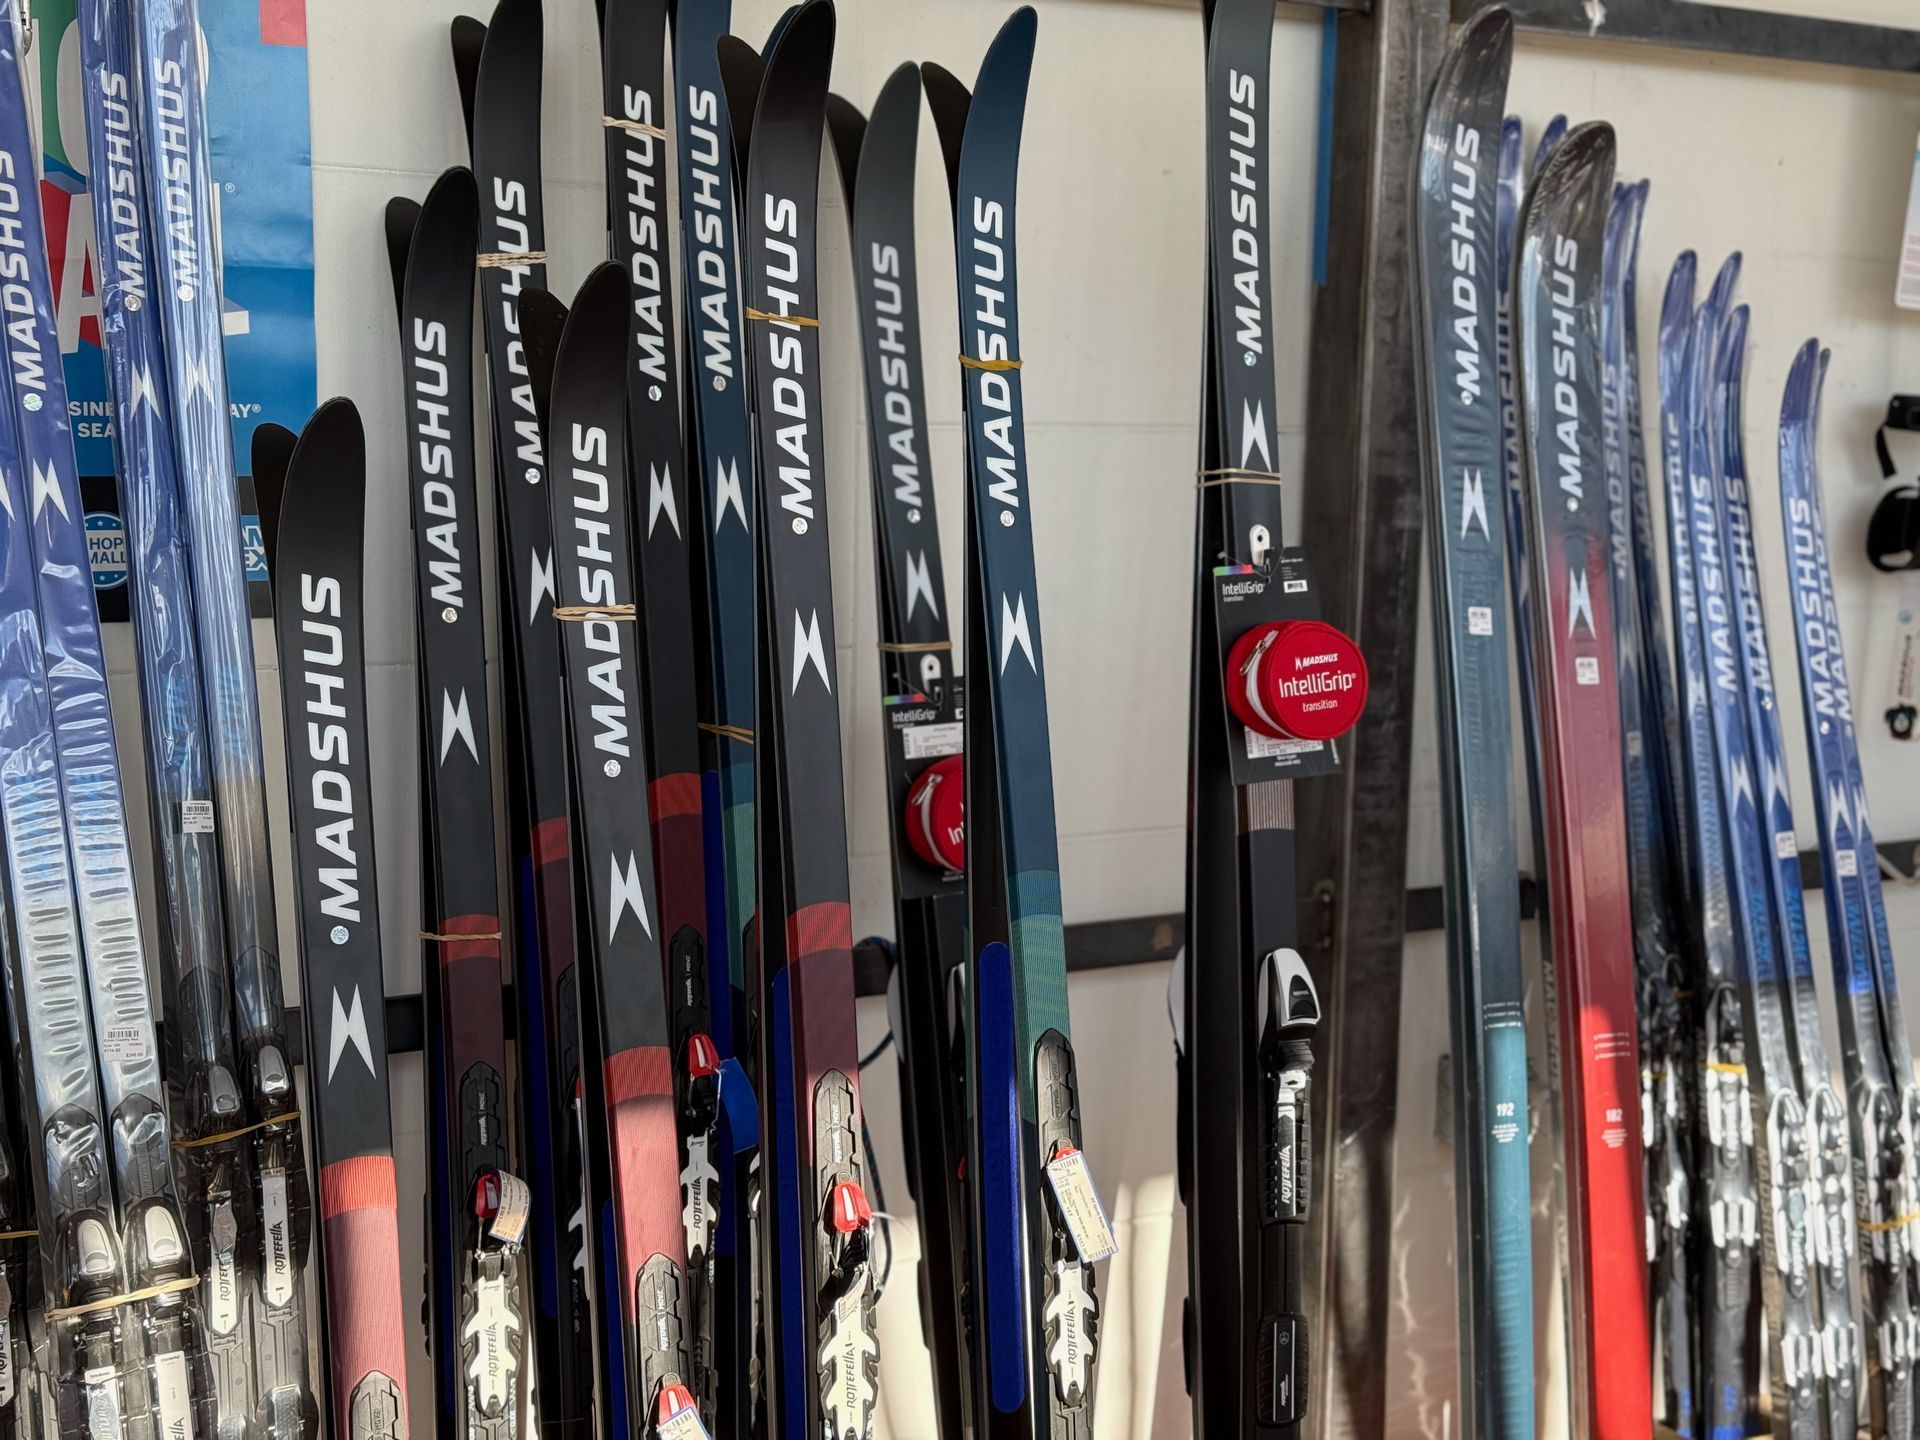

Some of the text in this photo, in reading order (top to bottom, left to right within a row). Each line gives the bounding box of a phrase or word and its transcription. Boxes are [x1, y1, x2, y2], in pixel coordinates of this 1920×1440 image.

[101, 68, 145, 300] MADSHUS
[154, 57, 199, 288] MADSHUS
[624, 84, 667, 383] MADSHUS
[689, 84, 735, 378] MADSHUS
[1230, 68, 1263, 355] MADSHUS
[1451, 123, 1482, 397] MADSHUS
[765, 193, 815, 520] MADSHUS
[871, 242, 923, 508] MADSHUS
[973, 195, 1020, 509] MADSHUS
[1553, 233, 1585, 499] MADSHUS
[414, 316, 464, 608] MADSHUS
[1602, 362, 1628, 567] MADSHUS
[572, 422, 631, 758] MADSHUS
[1303, 653, 1339, 667] MADSHUS
[1691, 474, 1740, 693] MADSHUS
[1726, 475, 1773, 694] MADSHUS
[1791, 497, 1837, 717] MADSHUS
[301, 573, 361, 923] MADSHUS
[1303, 699, 1338, 712] transition
[1786, 886, 1807, 960] ACTIVE
[1846, 900, 1866, 974] ACTIVE
[690, 1176, 702, 1229] ROTTEFELLA
[1278, 1145, 1291, 1204] ROTTEFELLA
[1496, 1102, 1514, 1117] 192
[269, 1221, 287, 1275] ROTTEFELLA
[484, 1322, 498, 1377] ROTTEFELLA
[1064, 1306, 1079, 1365] ROTTEFELLA
[841, 1347, 857, 1408] ROTTEFELLA
